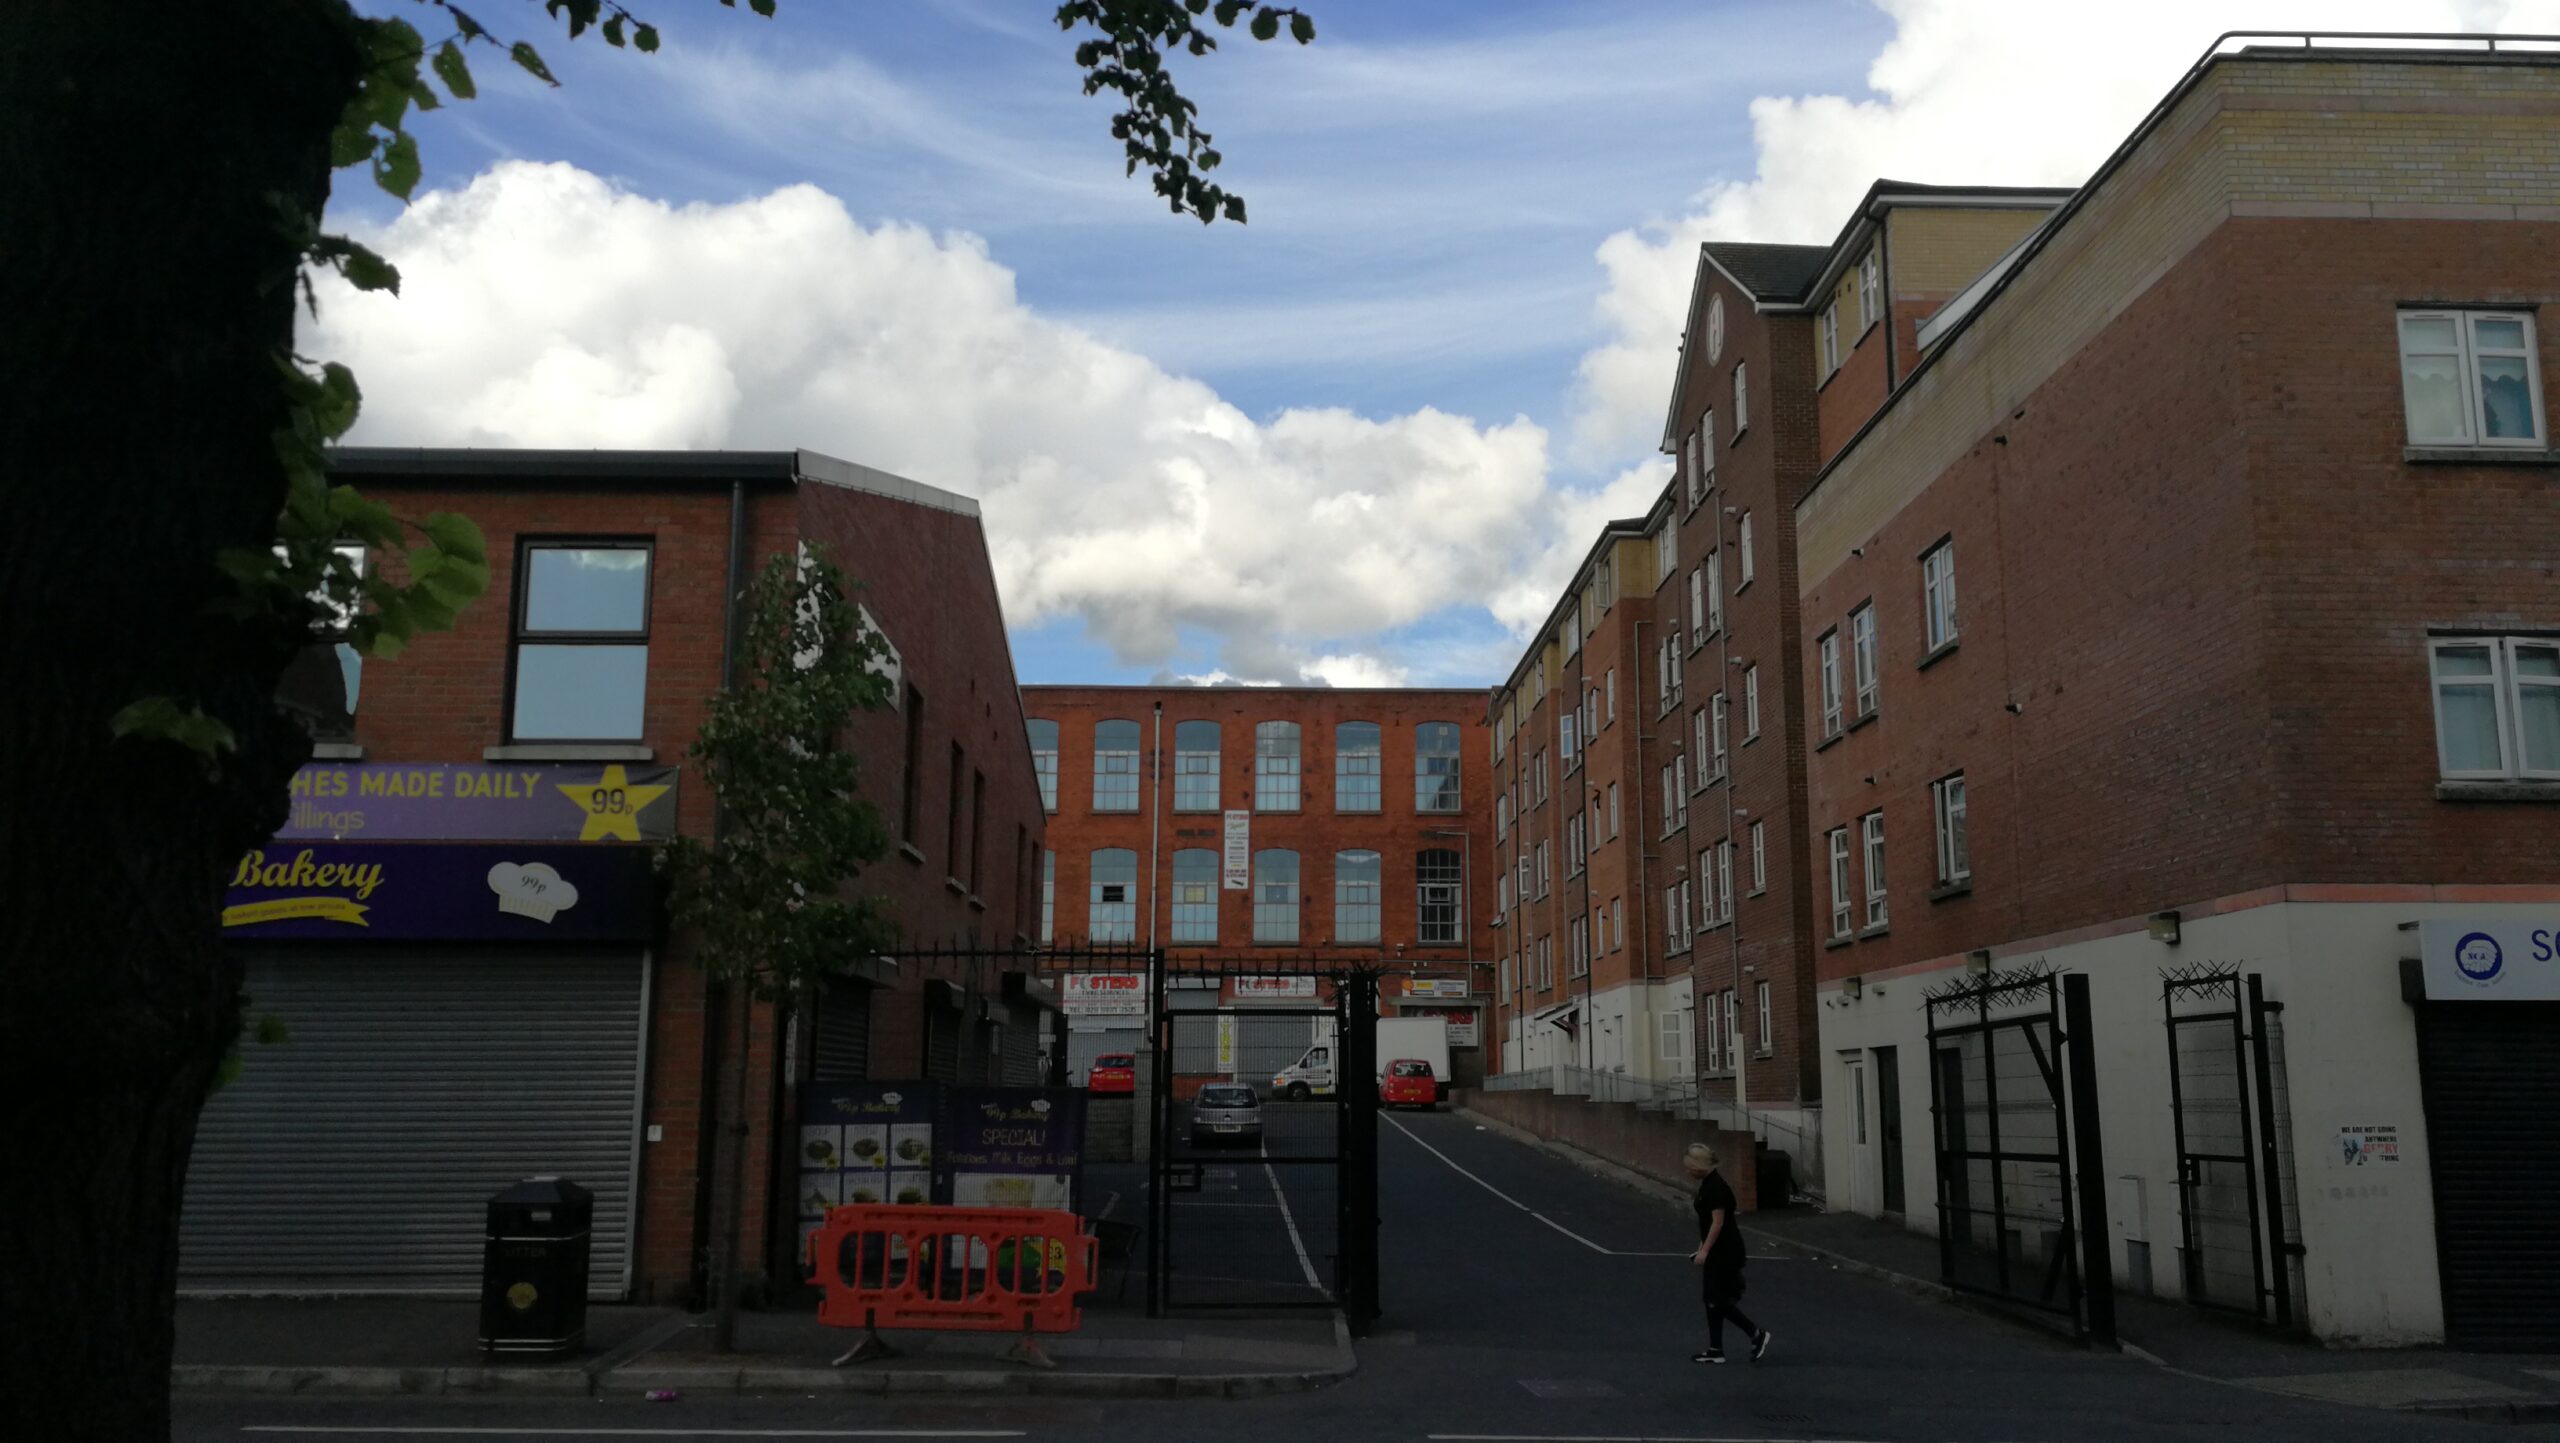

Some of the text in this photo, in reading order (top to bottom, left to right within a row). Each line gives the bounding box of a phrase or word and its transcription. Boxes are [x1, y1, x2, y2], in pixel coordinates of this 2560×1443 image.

[360, 771, 443, 797] MADE
[455, 772, 541, 798] DAILY
[592, 788, 633, 815] 99p
[228, 848, 385, 900] Bakery
[521, 875, 547, 895] 99p
[981, 1128, 1046, 1146] SPECIAL!
